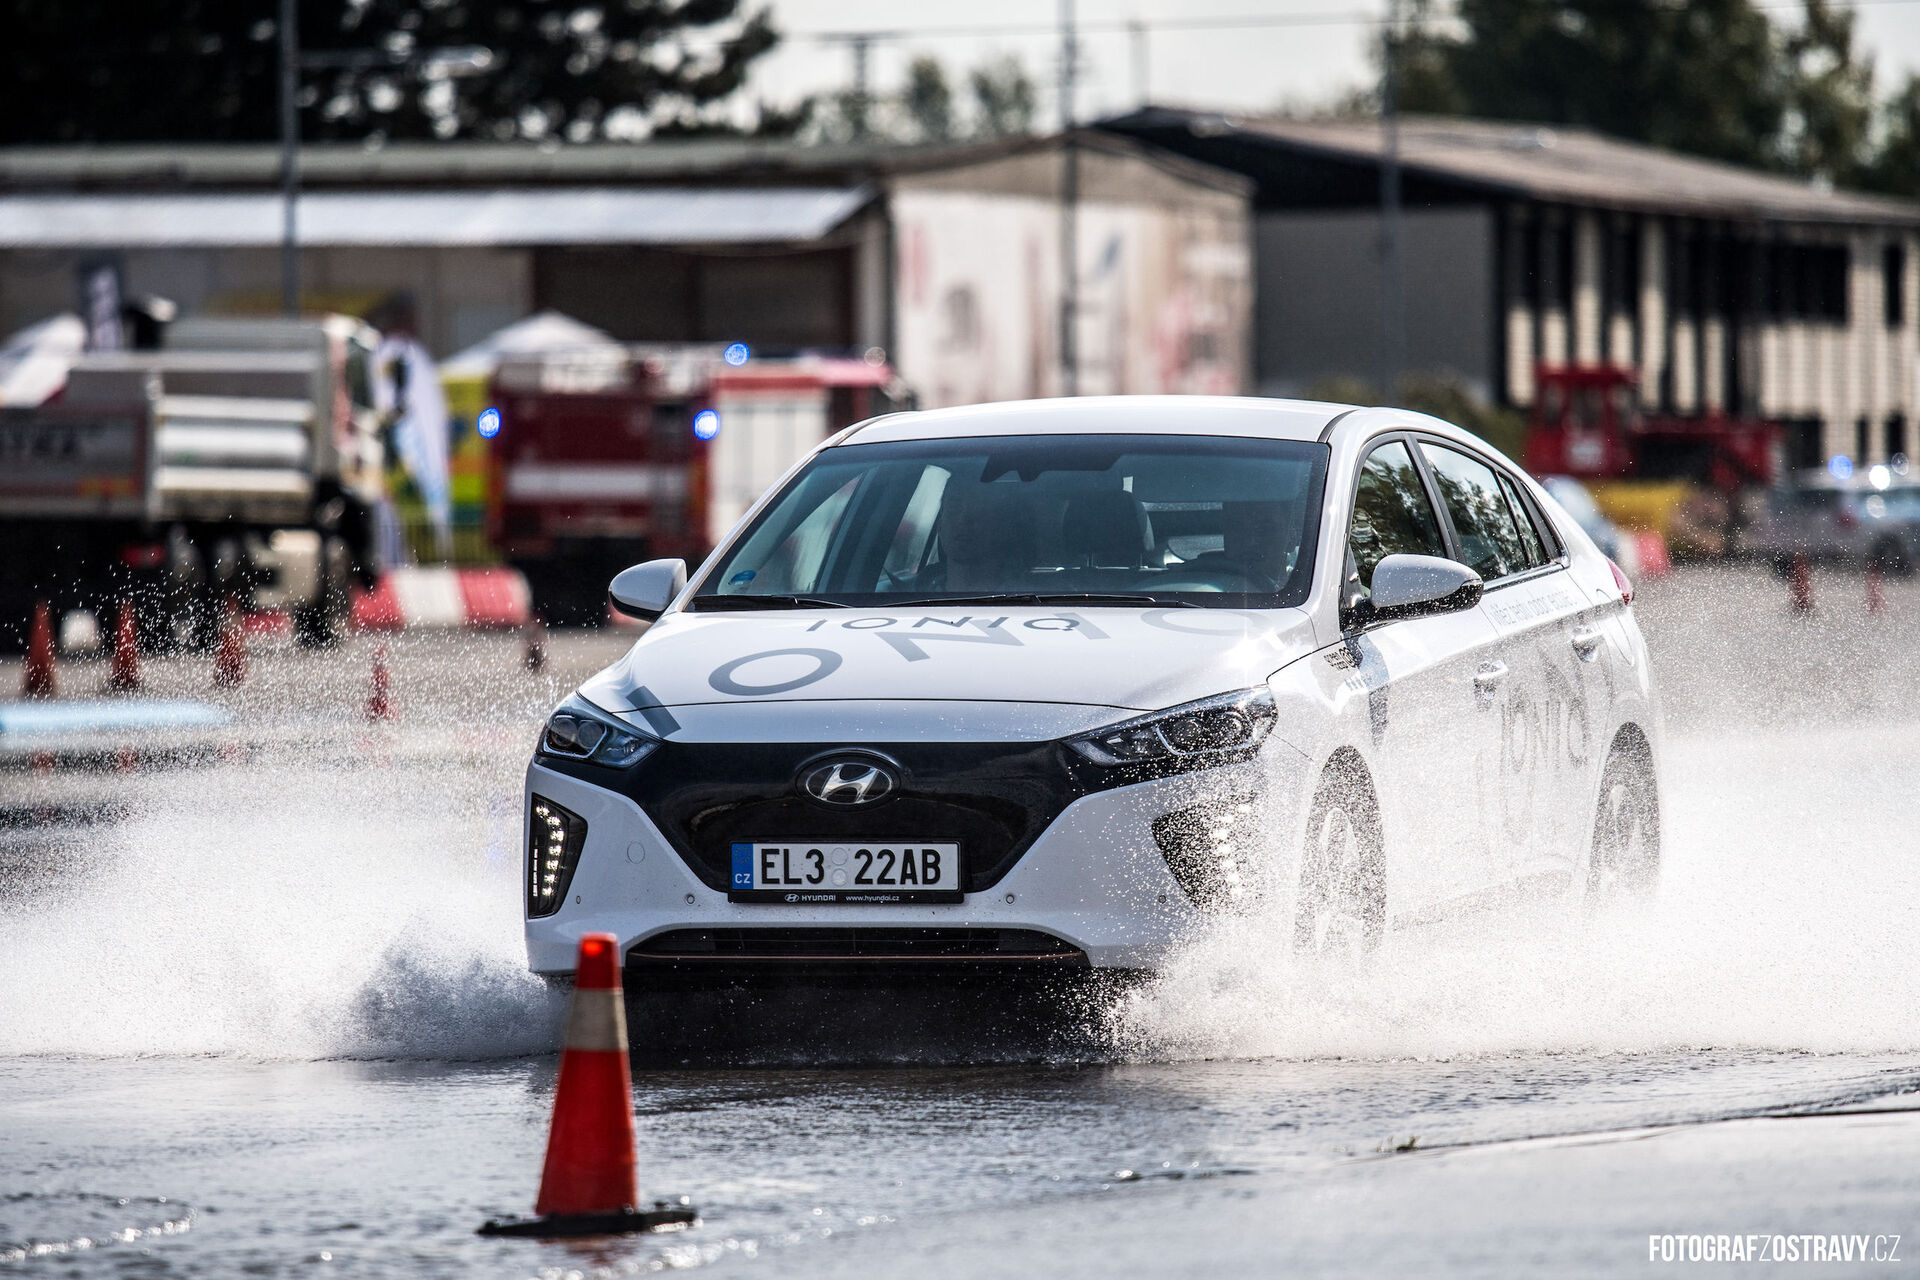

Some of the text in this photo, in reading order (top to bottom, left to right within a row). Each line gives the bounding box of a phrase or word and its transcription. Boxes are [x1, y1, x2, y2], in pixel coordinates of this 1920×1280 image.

[806, 616, 1080, 632] IONIQ
[761, 848, 941, 886] EL3 22AB
[734, 873, 751, 885] CZ
[801, 894, 836, 902] HYUNDAI
